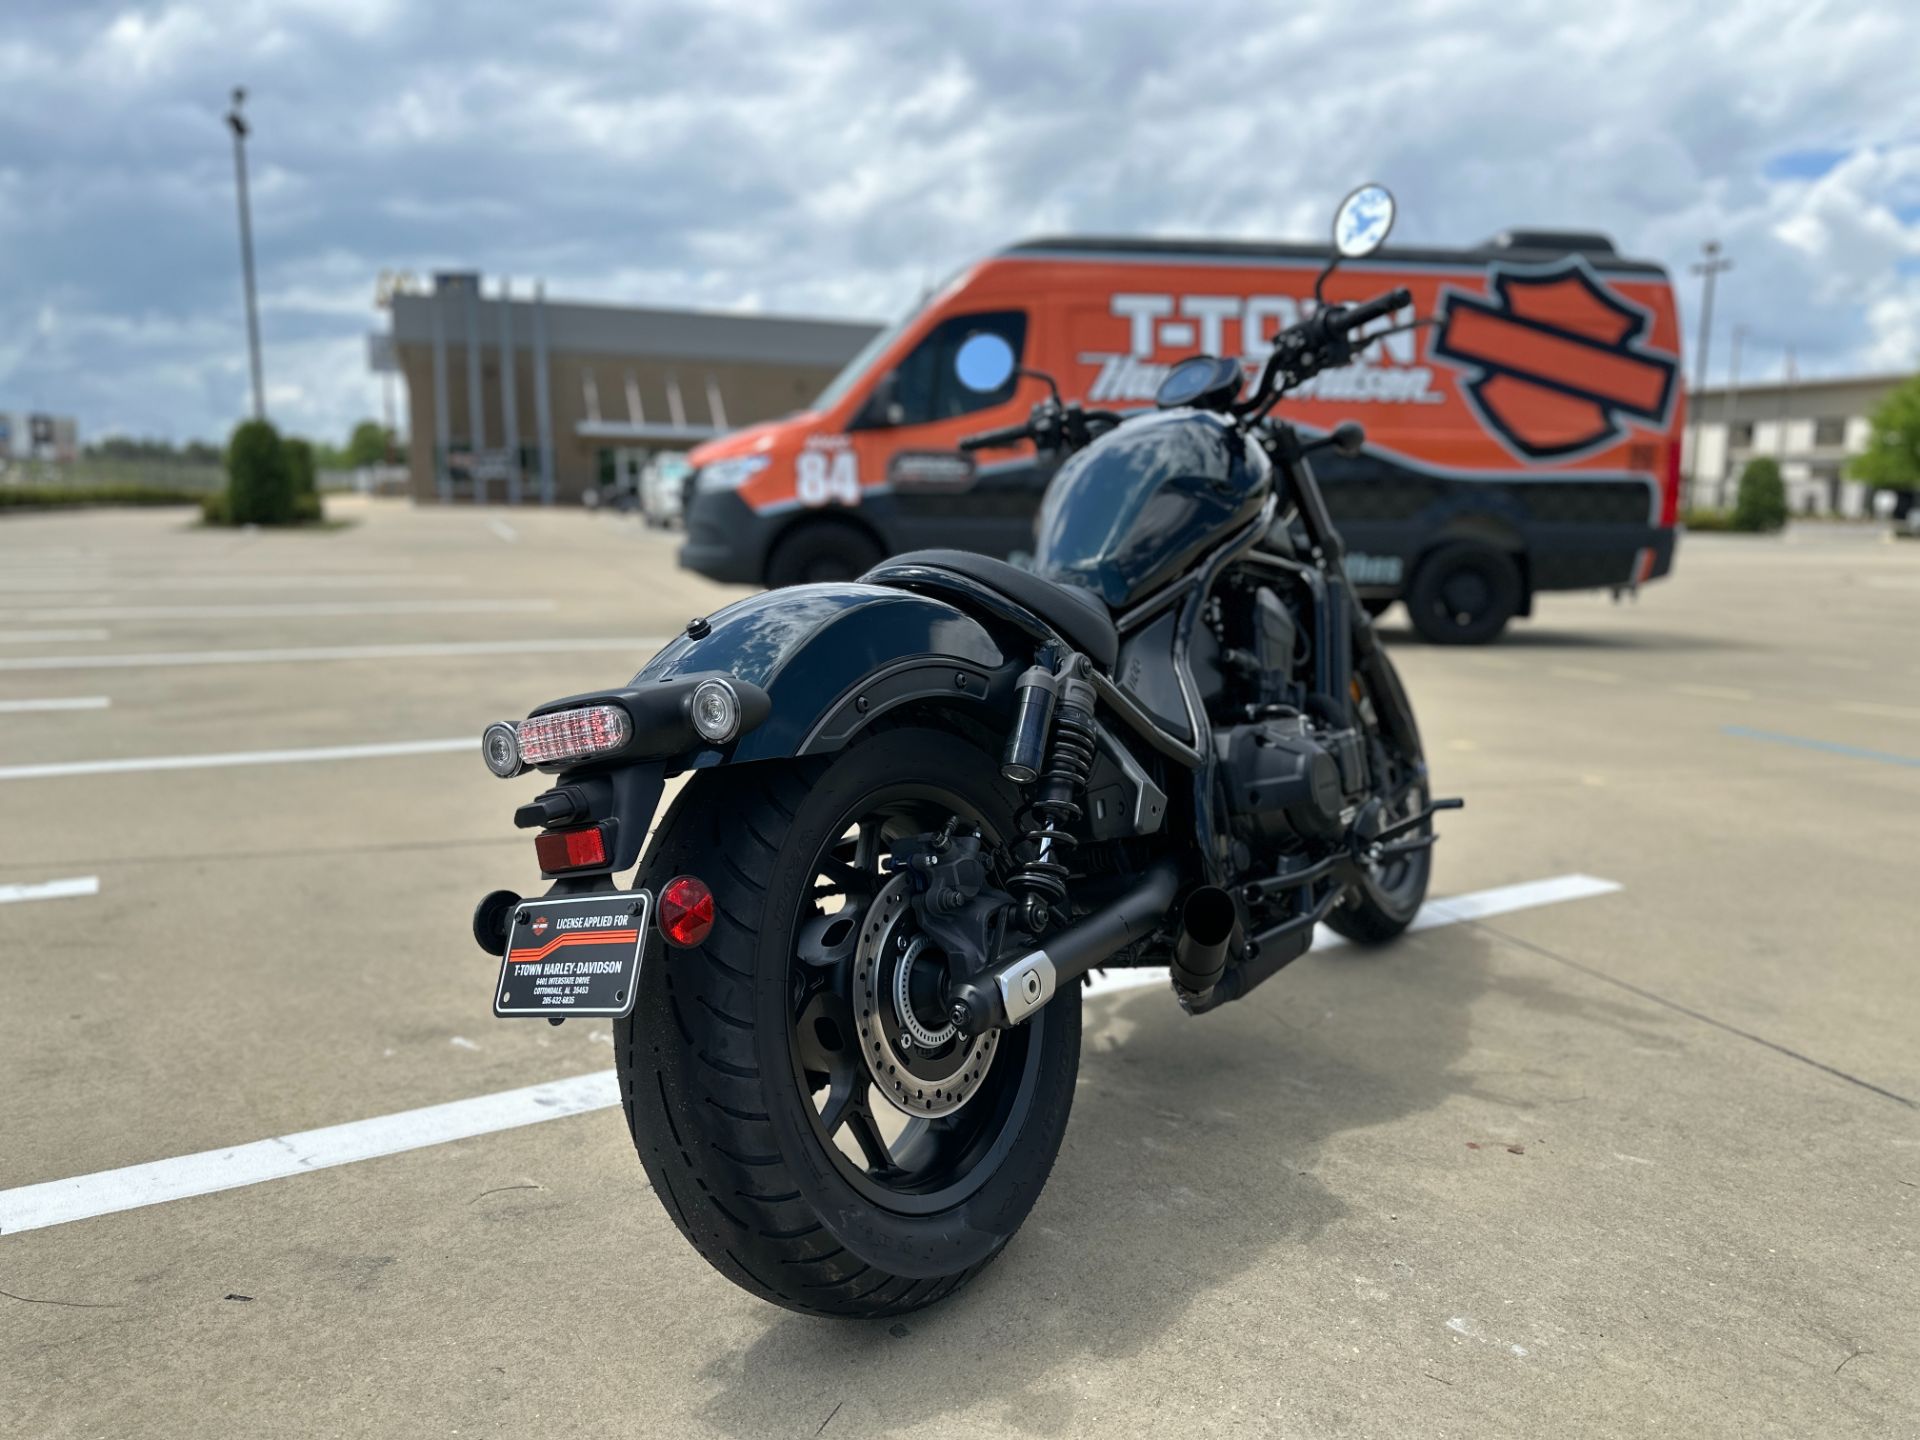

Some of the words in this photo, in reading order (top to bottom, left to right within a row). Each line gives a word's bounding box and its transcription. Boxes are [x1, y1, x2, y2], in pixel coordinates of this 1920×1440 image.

[1110, 293, 1416, 363] T-TON
[796, 452, 859, 505] 84
[556, 917, 584, 930] LICENSE
[583, 916, 612, 928] APPLIED
[613, 914, 629, 927] FOR
[514, 963, 543, 976] T-TOWN
[543, 961, 622, 975] HARLEY-DAVIDSON
[575, 976, 590, 985] DRIVE
